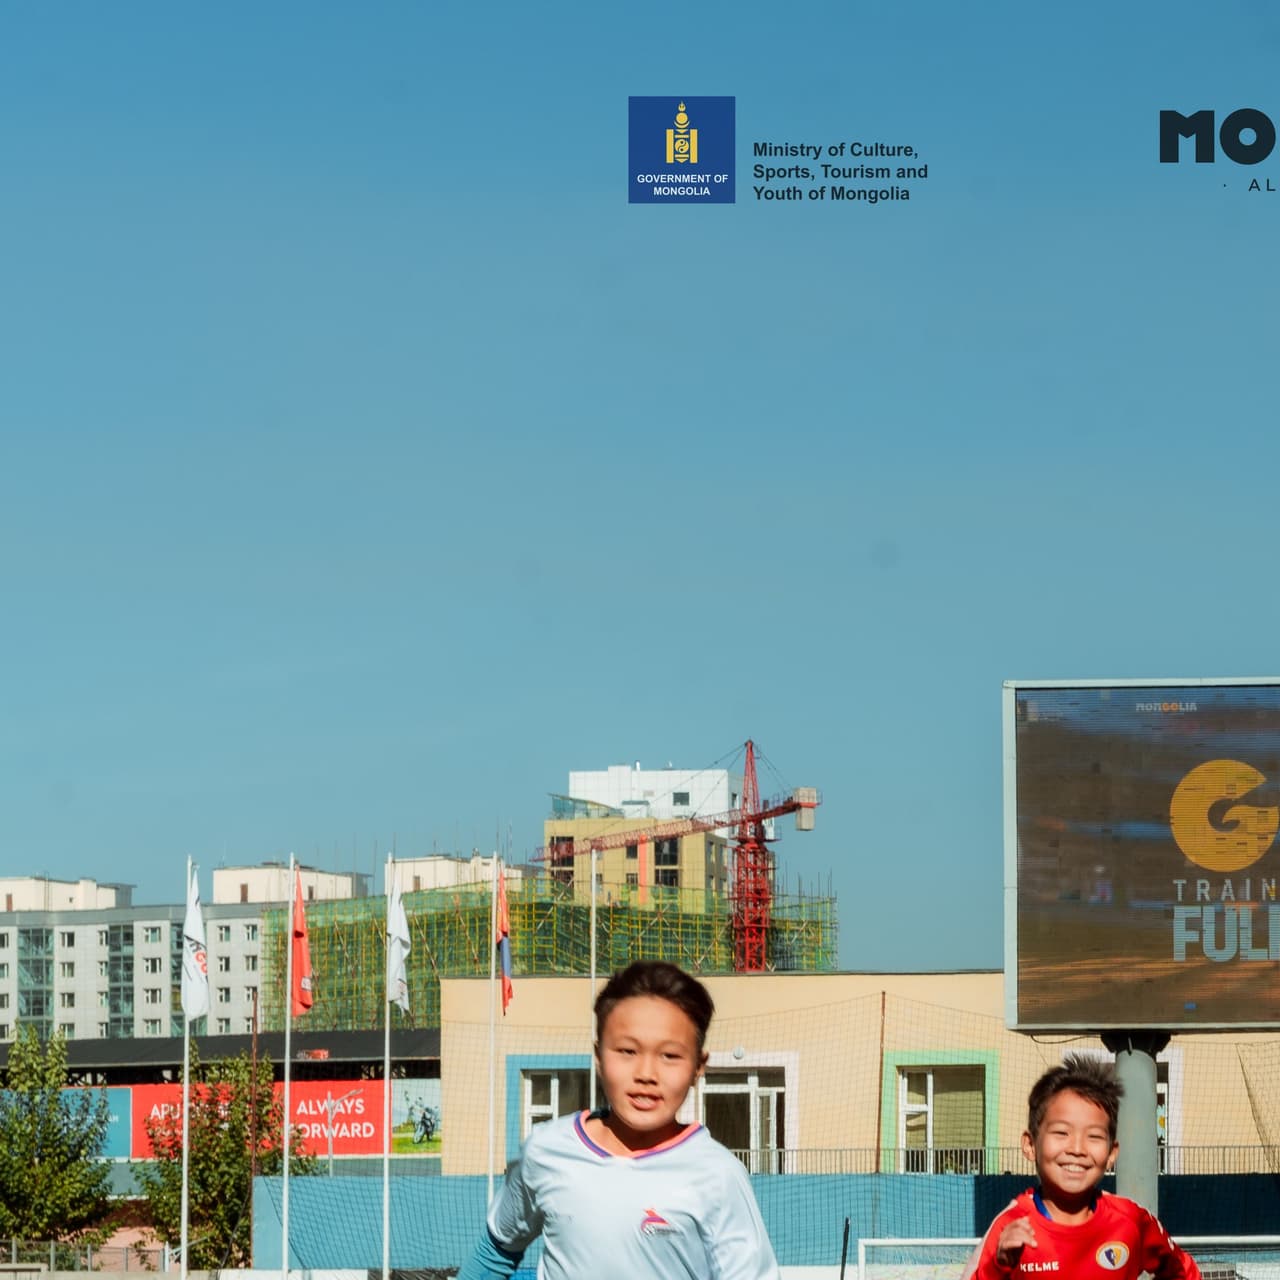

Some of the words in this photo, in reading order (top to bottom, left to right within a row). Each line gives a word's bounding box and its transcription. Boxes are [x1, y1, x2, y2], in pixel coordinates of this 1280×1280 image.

[1172, 878, 1276, 901] TRAIN
[296, 1098, 365, 1116] ALWAYS
[290, 1121, 376, 1139] ORWARD
[1020, 1261, 1060, 1273] KELME
